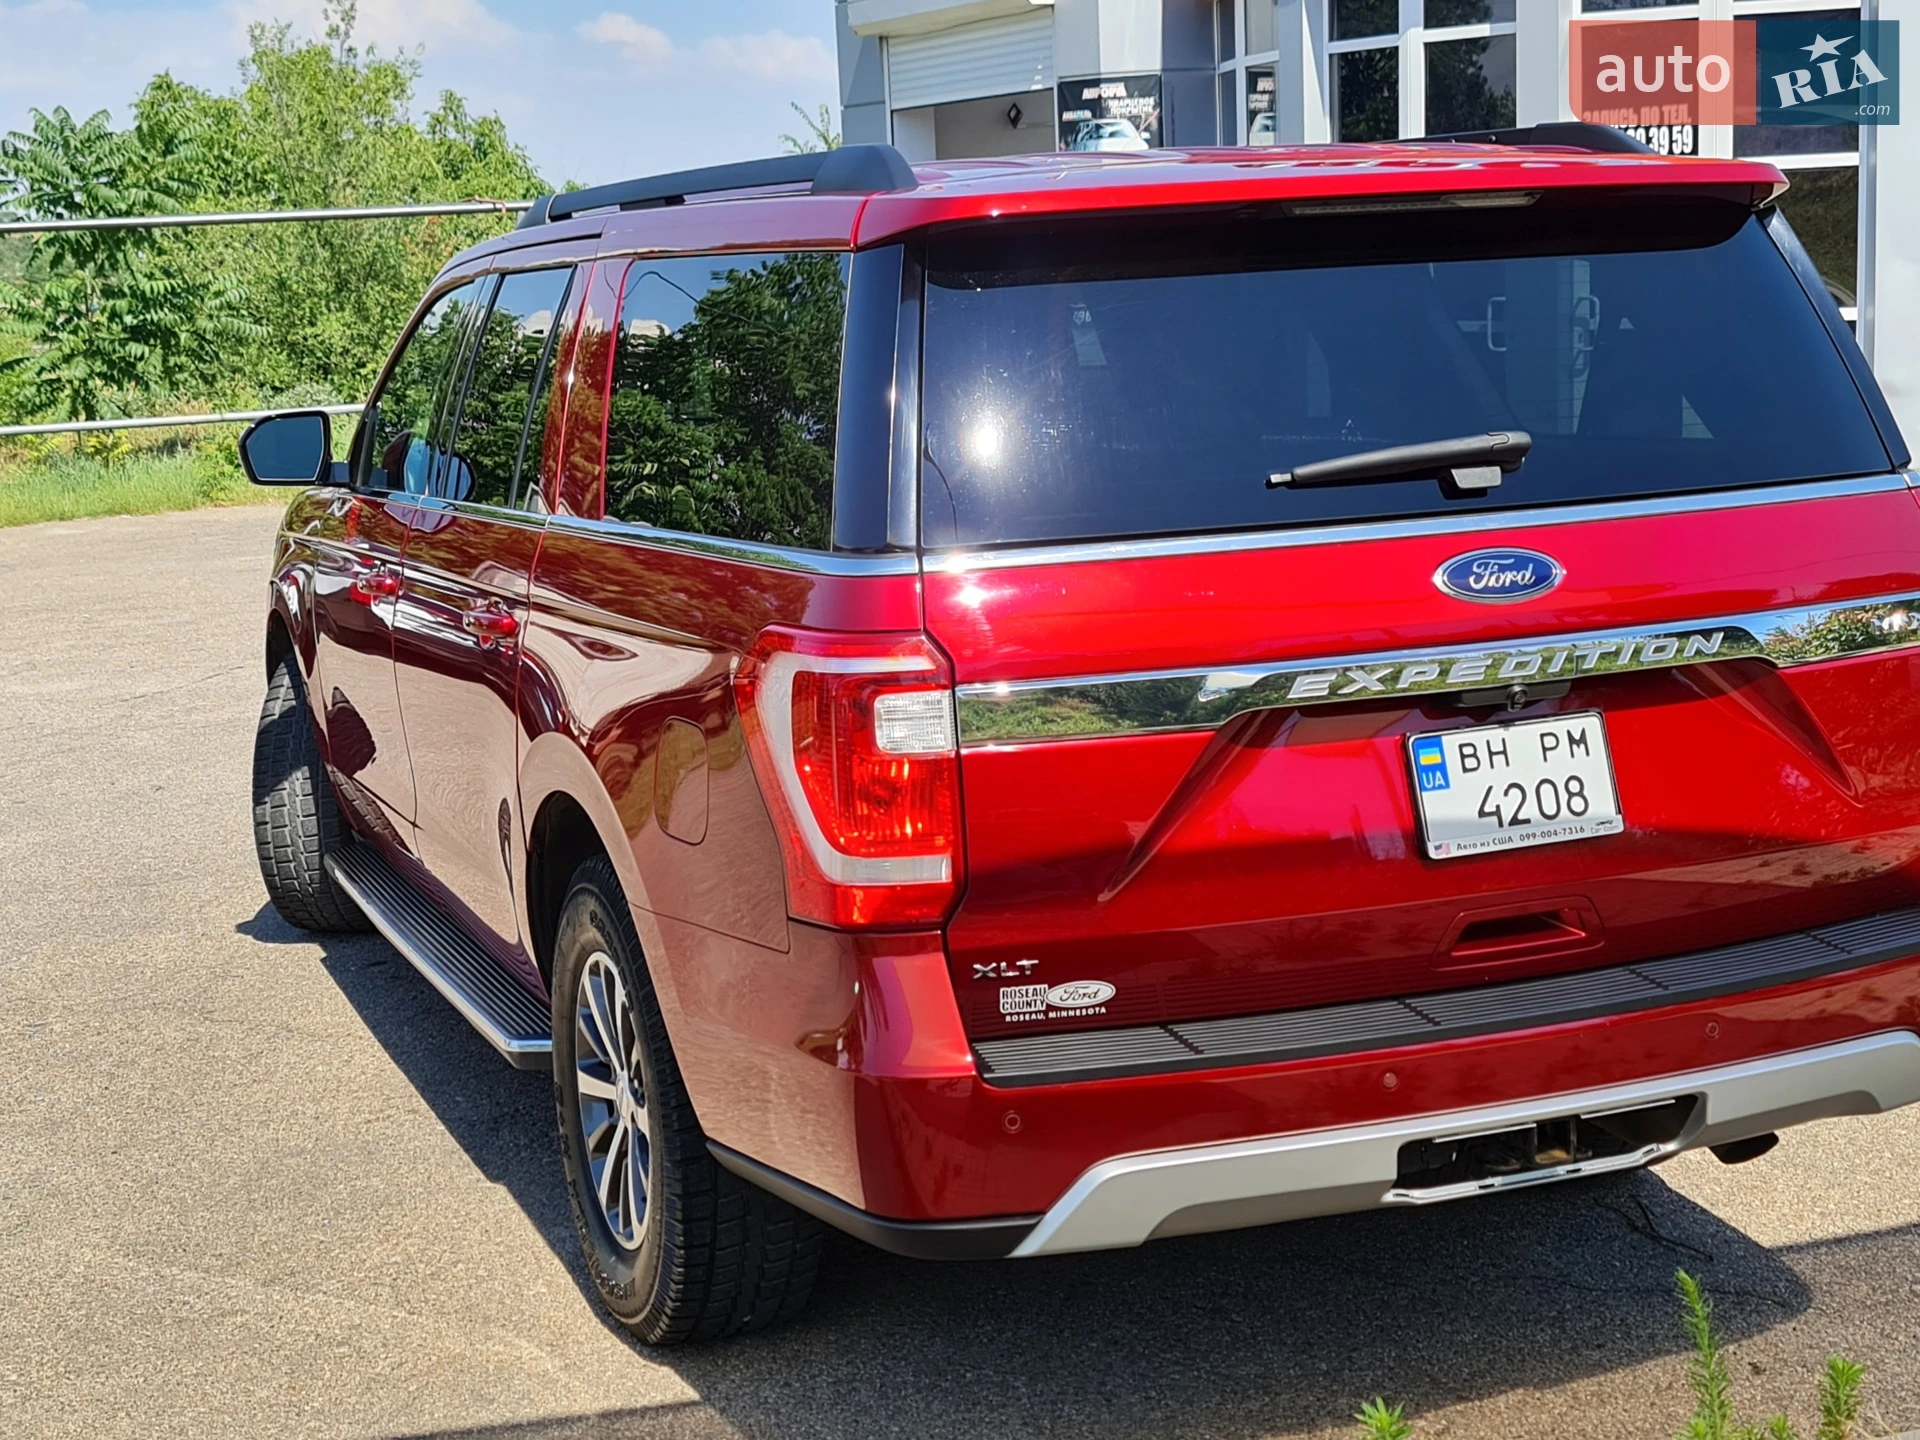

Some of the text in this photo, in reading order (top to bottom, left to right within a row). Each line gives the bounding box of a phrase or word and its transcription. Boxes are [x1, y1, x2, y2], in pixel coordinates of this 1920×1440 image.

[1640, 104, 1660, 126] ПО
[1661, 103, 1692, 125] ТЕЛ.
[1648, 126, 1669, 156] 39
[1672, 125, 1693, 154] 59
[1468, 559, 1536, 590] Ford
[1287, 631, 1725, 700] EXPEDITION
[1458, 727, 1590, 774] BH PM
[1422, 772, 1446, 789] UA
[1477, 775, 1589, 828] 4208
[1456, 842, 1478, 851] Авто
[1492, 836, 1514, 846] США
[1519, 826, 1585, 842] 099-004-7316
[972, 960, 1039, 979] XLT
[1002, 986, 1100, 1003] ROSEAU Ford
[1002, 998, 1046, 1011] COUNTY
[1005, 1006, 1107, 1023] ROSEAU, MINNESOTA
